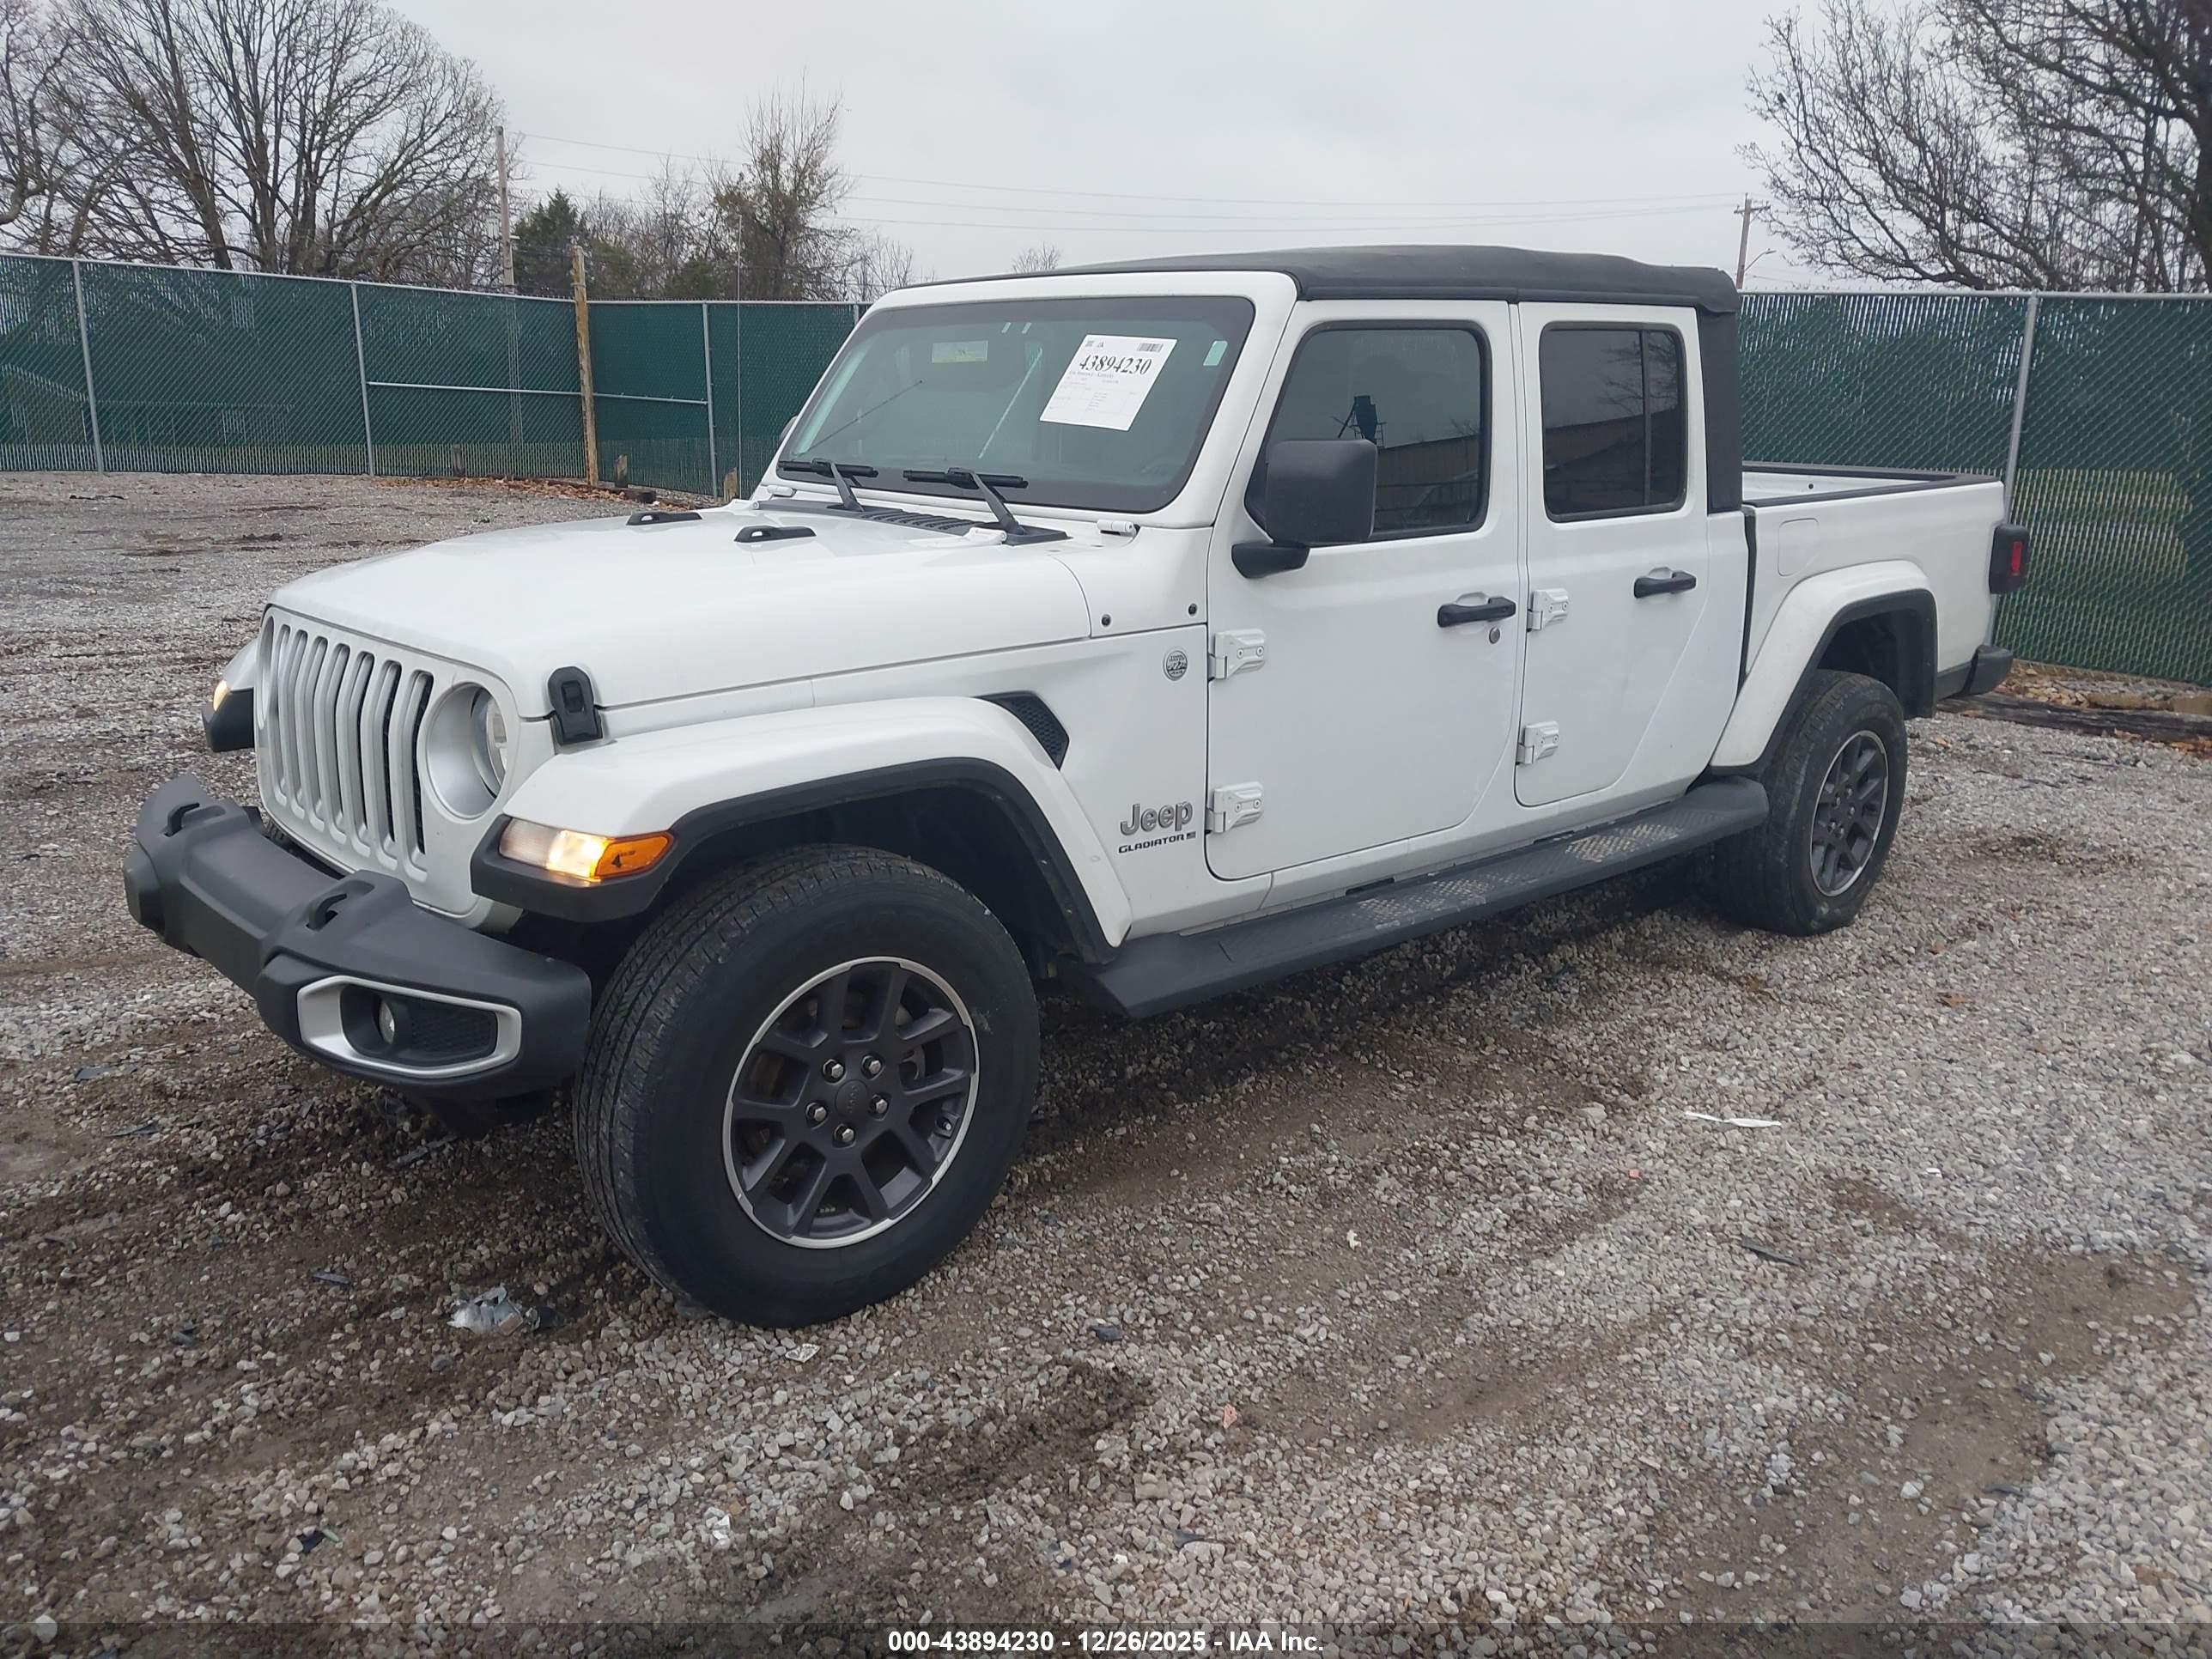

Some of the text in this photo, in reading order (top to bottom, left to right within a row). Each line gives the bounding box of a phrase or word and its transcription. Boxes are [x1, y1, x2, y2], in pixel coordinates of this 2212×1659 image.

[1079, 354, 1152, 375] 43894230
[1120, 801, 1193, 836] Jeep
[1118, 833, 1185, 854] GLADIATOR
